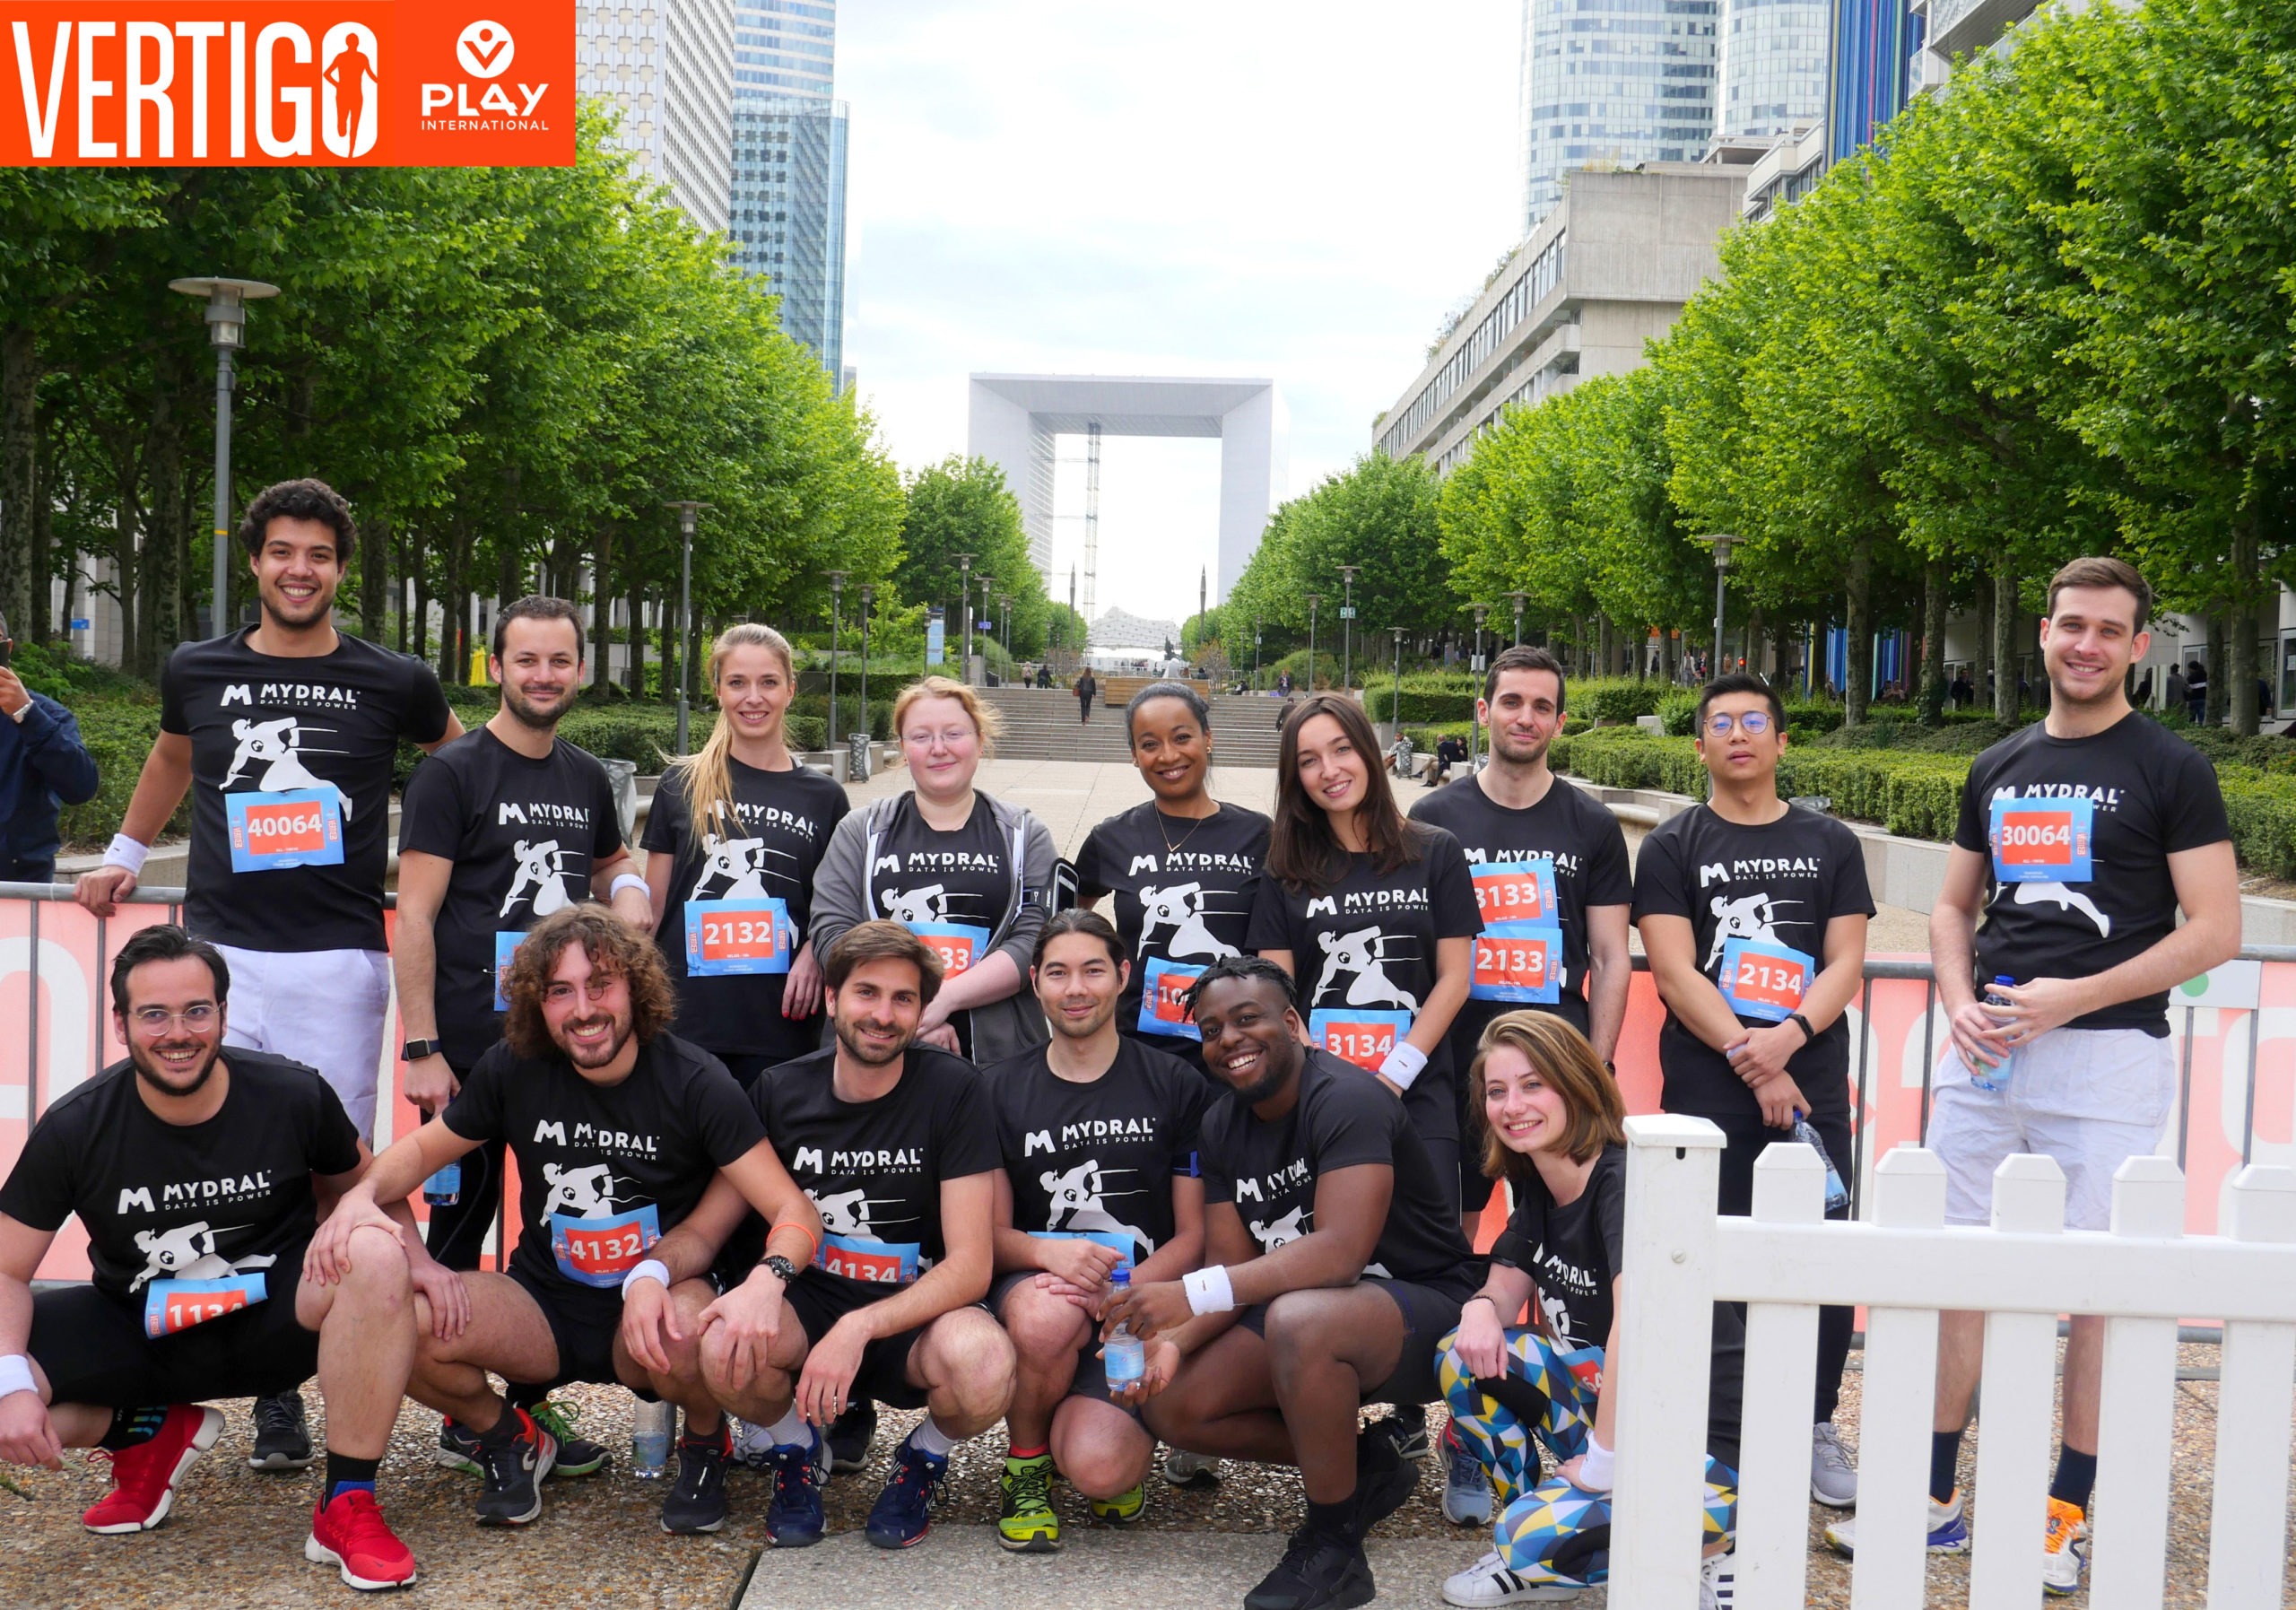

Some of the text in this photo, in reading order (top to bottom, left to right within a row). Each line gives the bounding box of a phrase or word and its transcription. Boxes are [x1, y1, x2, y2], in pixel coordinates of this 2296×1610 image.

[221, 683, 356, 706] M MYDRAL
[2023, 784, 2118, 804] MYDRAL
[499, 803, 528, 825] M
[735, 803, 814, 837] MYDRAL
[2092, 805, 2116, 813] WER
[248, 814, 324, 837] 40064
[2002, 825, 2071, 846] 30064
[874, 853, 998, 876] M MYDRAL
[962, 866, 998, 875] POWER
[1128, 853, 1252, 876] M MYDRAL
[1552, 866, 1575, 878] OWER
[1700, 857, 1818, 888] M MYDRAL
[1306, 887, 1429, 918] M MYDRAL
[705, 921, 771, 945] 2132
[940, 946, 969, 970] 33
[1477, 948, 1544, 972] 2133
[1738, 963, 1801, 996] 2134
[1328, 1034, 1392, 1057] 3134
[534, 1119, 657, 1153] M MDRAL
[1024, 1118, 1153, 1157] M MYDRAL
[620, 1150, 657, 1161] POWER
[793, 1146, 921, 1174] M MYDRAL
[883, 1166, 921, 1174] POWER
[117, 1171, 270, 1214] M MYDRAL
[165, 1189, 271, 1210] DATA IS POWER
[1237, 1178, 1264, 1203] M
[1268, 1188, 1290, 1202] ATA
[570, 1233, 641, 1260] 4132
[826, 1258, 897, 1283] 4134
[1548, 1274, 1567, 1285] ATA
